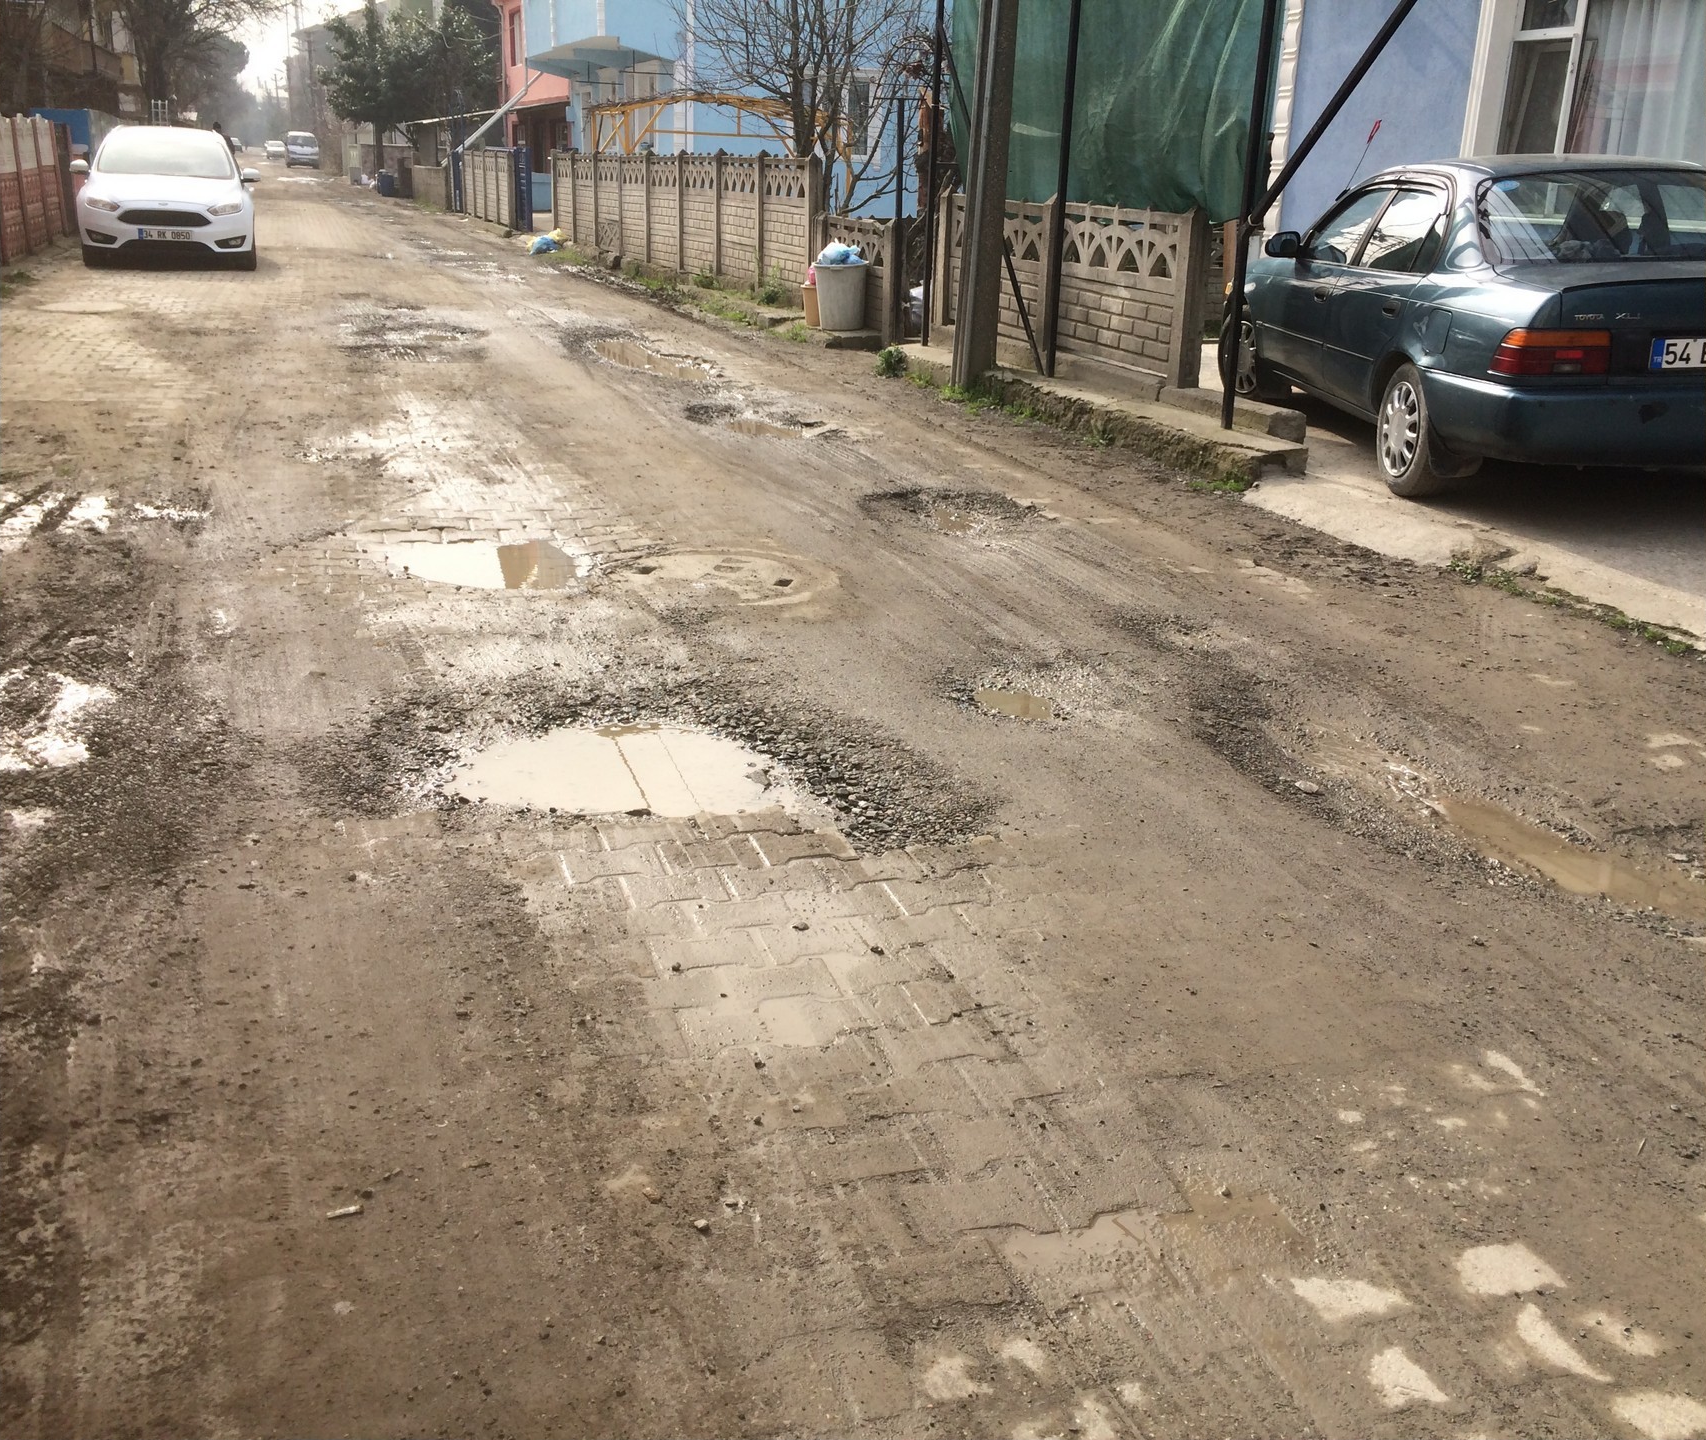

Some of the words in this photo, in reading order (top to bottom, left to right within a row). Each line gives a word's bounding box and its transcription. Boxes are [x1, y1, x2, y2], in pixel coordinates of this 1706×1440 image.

[143, 230, 153, 239] 34
[157, 231, 167, 240] RK
[171, 232, 191, 240] 0850
[1664, 342, 1692, 366] 54
